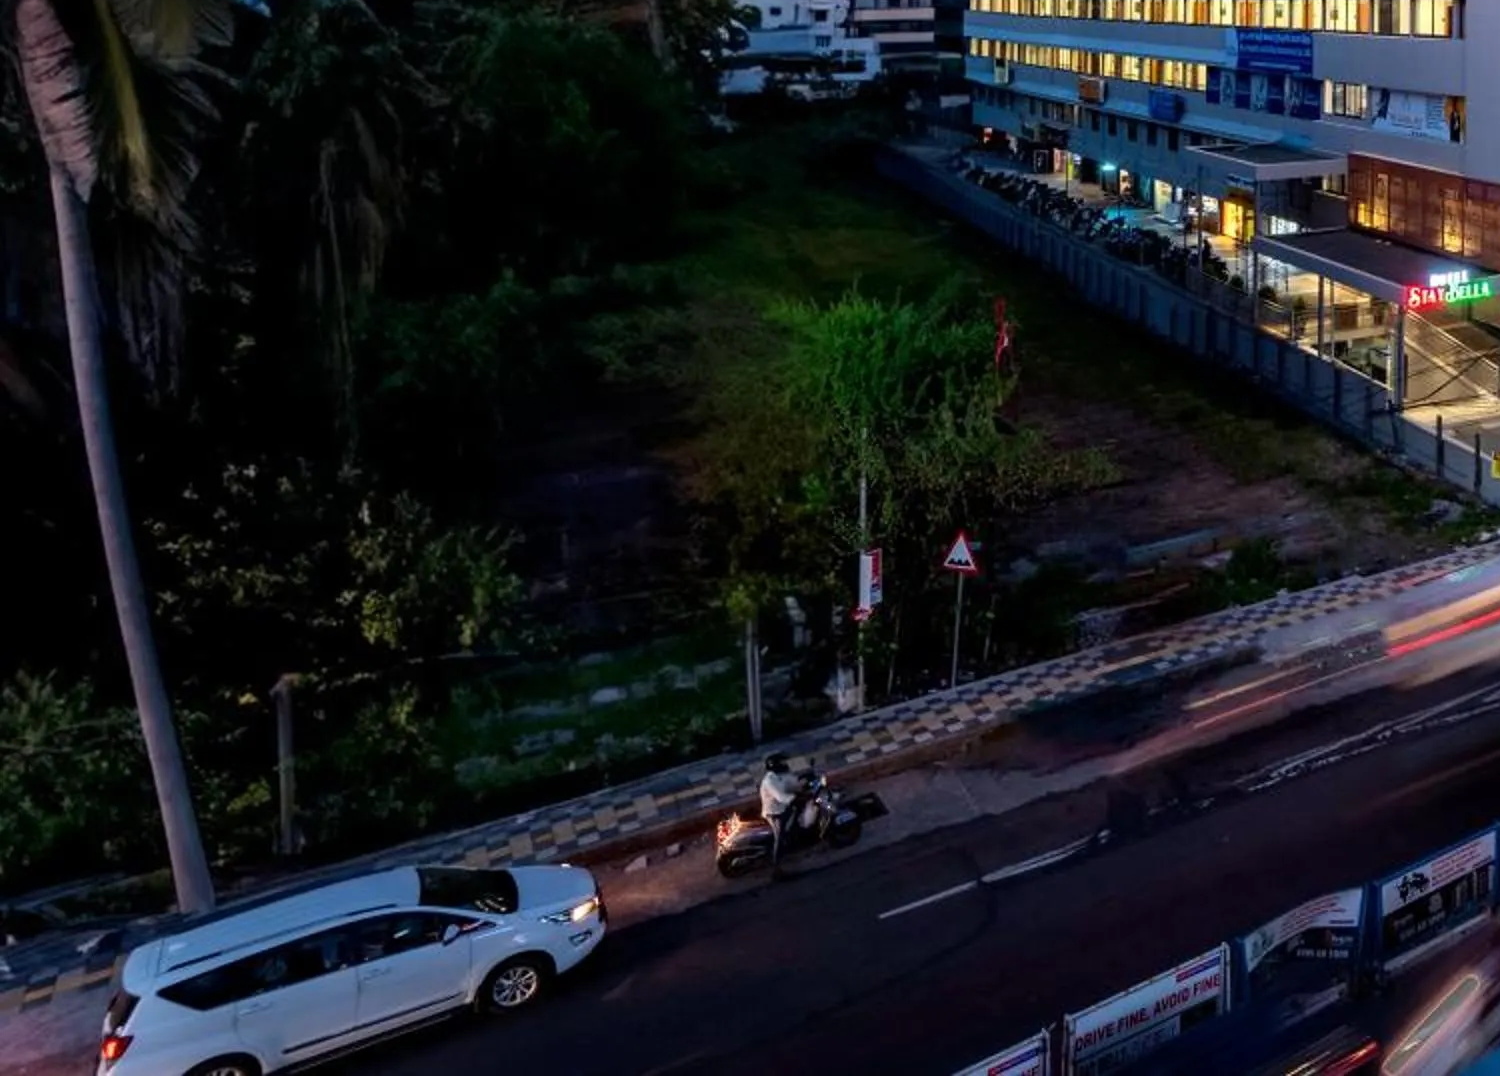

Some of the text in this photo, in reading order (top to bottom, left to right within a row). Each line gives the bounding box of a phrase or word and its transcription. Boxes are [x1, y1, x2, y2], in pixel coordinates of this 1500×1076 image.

[1074, 1022, 1115, 1052] DRIVE
[1153, 987, 1190, 1018] AVOID
[1193, 972, 1220, 997] FINE
